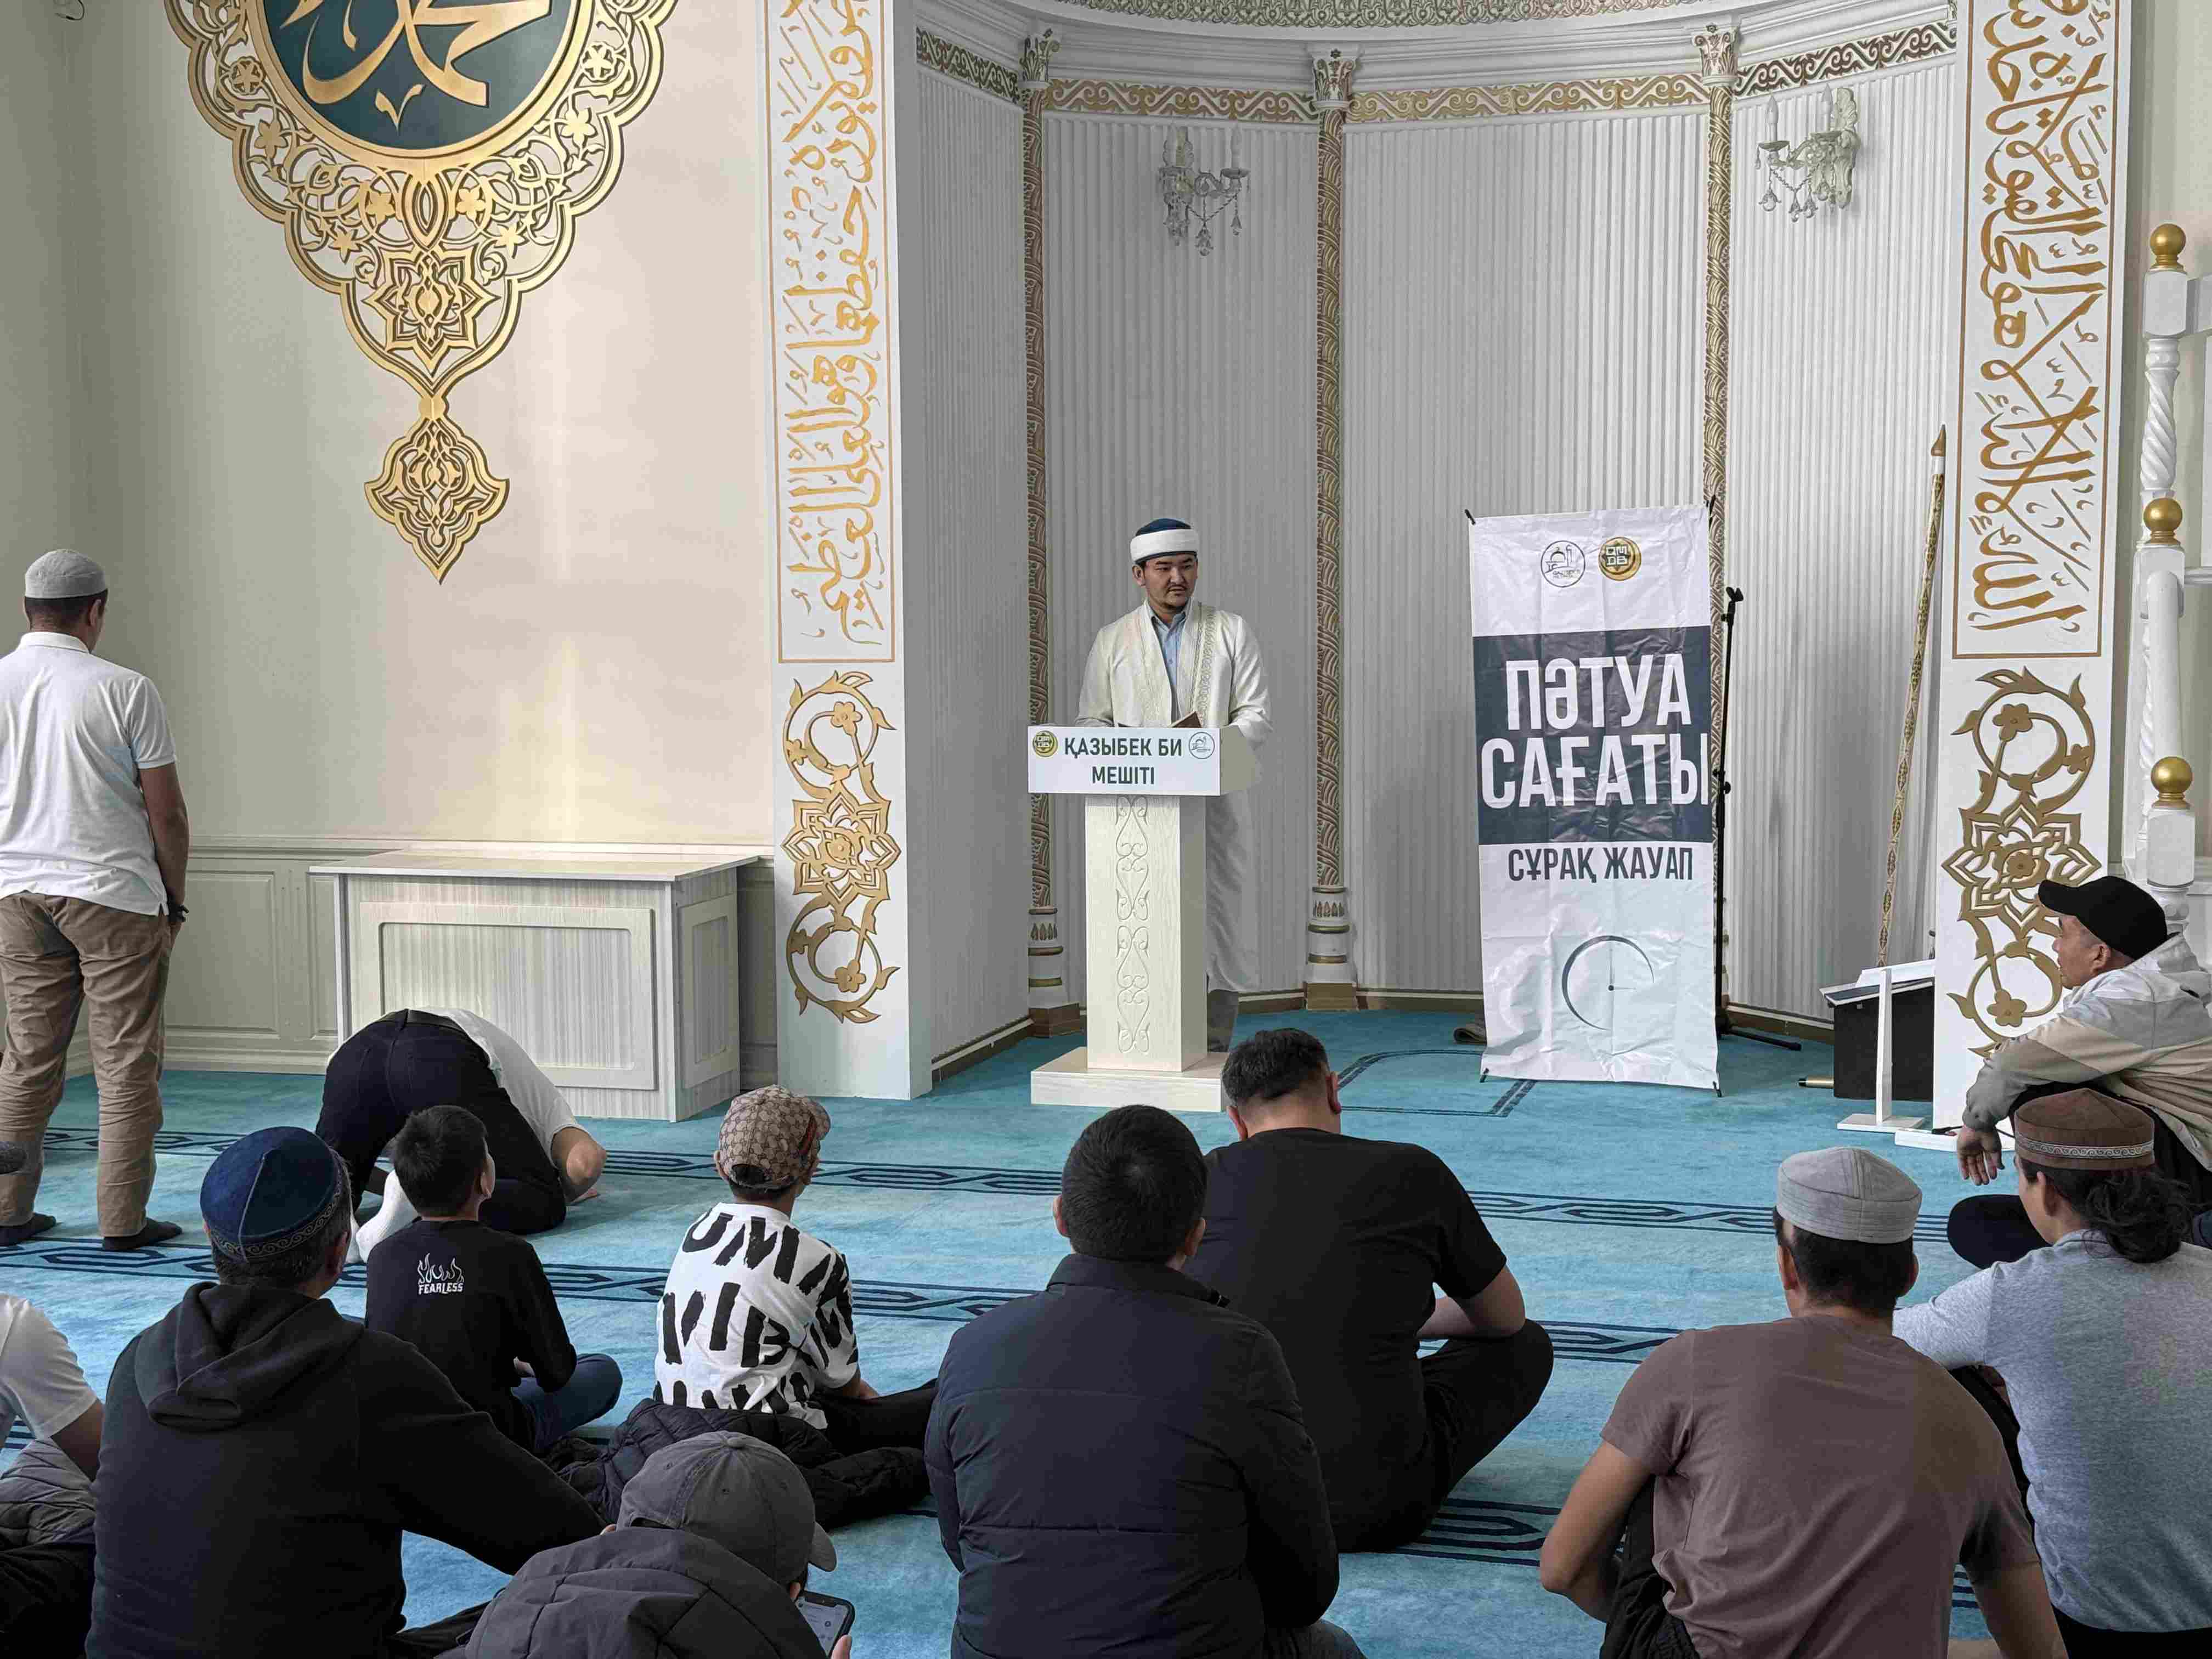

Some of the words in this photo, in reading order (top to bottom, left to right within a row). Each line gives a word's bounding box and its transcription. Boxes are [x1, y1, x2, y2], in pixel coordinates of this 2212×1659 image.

[1505, 653, 1691, 731] ПӘТУА
[1064, 737, 1153, 759] ҚАЗЫБЕК
[1158, 738, 1182, 757] БИ
[1092, 766, 1154, 785] МЕШІТІ
[1481, 733, 1708, 809] САҒАТЫ
[1508, 848, 1596, 883] СҰРАҚ
[1603, 847, 1694, 881] ЖАУАП
[418, 1282, 464, 1295] FEARLESS
